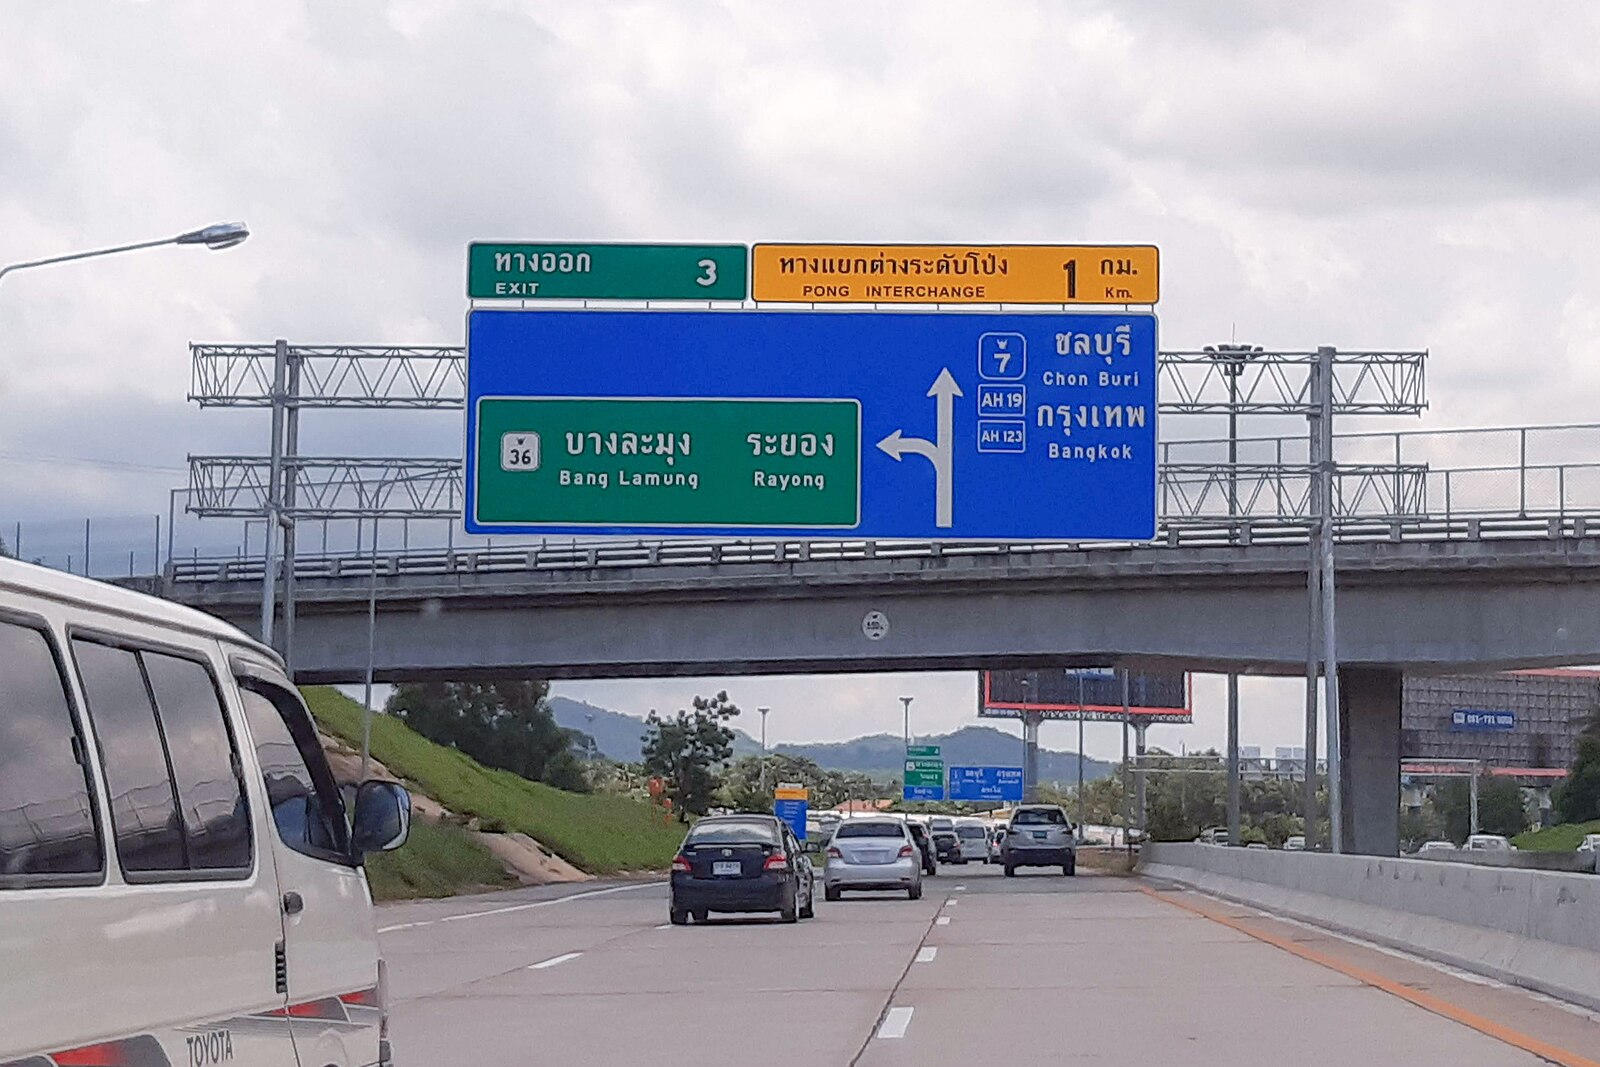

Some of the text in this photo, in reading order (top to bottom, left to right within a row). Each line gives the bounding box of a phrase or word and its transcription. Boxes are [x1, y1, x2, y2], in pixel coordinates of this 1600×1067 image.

[495, 253, 590, 272] ทางออก
[780, 252, 1007, 274] ทางแยกต่างระดับโป่ง
[1101, 259, 1137, 275] กม.
[697, 260, 716, 285] 3
[1064, 260, 1075, 298] 1
[496, 283, 539, 294] EXIT
[803, 286, 984, 297] PONG INTERCHANGE
[1056, 325, 1130, 364] ชลบุรี
[994, 353, 1010, 373] 7
[1043, 372, 1138, 386] Chon Buri
[982, 393, 1022, 407] AH 19
[1038, 405, 1144, 436] กรุงเทพ
[747, 434, 833, 456] ระยอง
[982, 430, 1022, 442] AH 123
[510, 449, 531, 465] 36
[566, 433, 689, 465] บางละมุง
[1049, 443, 1131, 462] Bangkok
[560, 470, 697, 489] Bang Lamung
[755, 472, 824, 490] Rayong
[186, 1030, 233, 1067] TOYOTA
